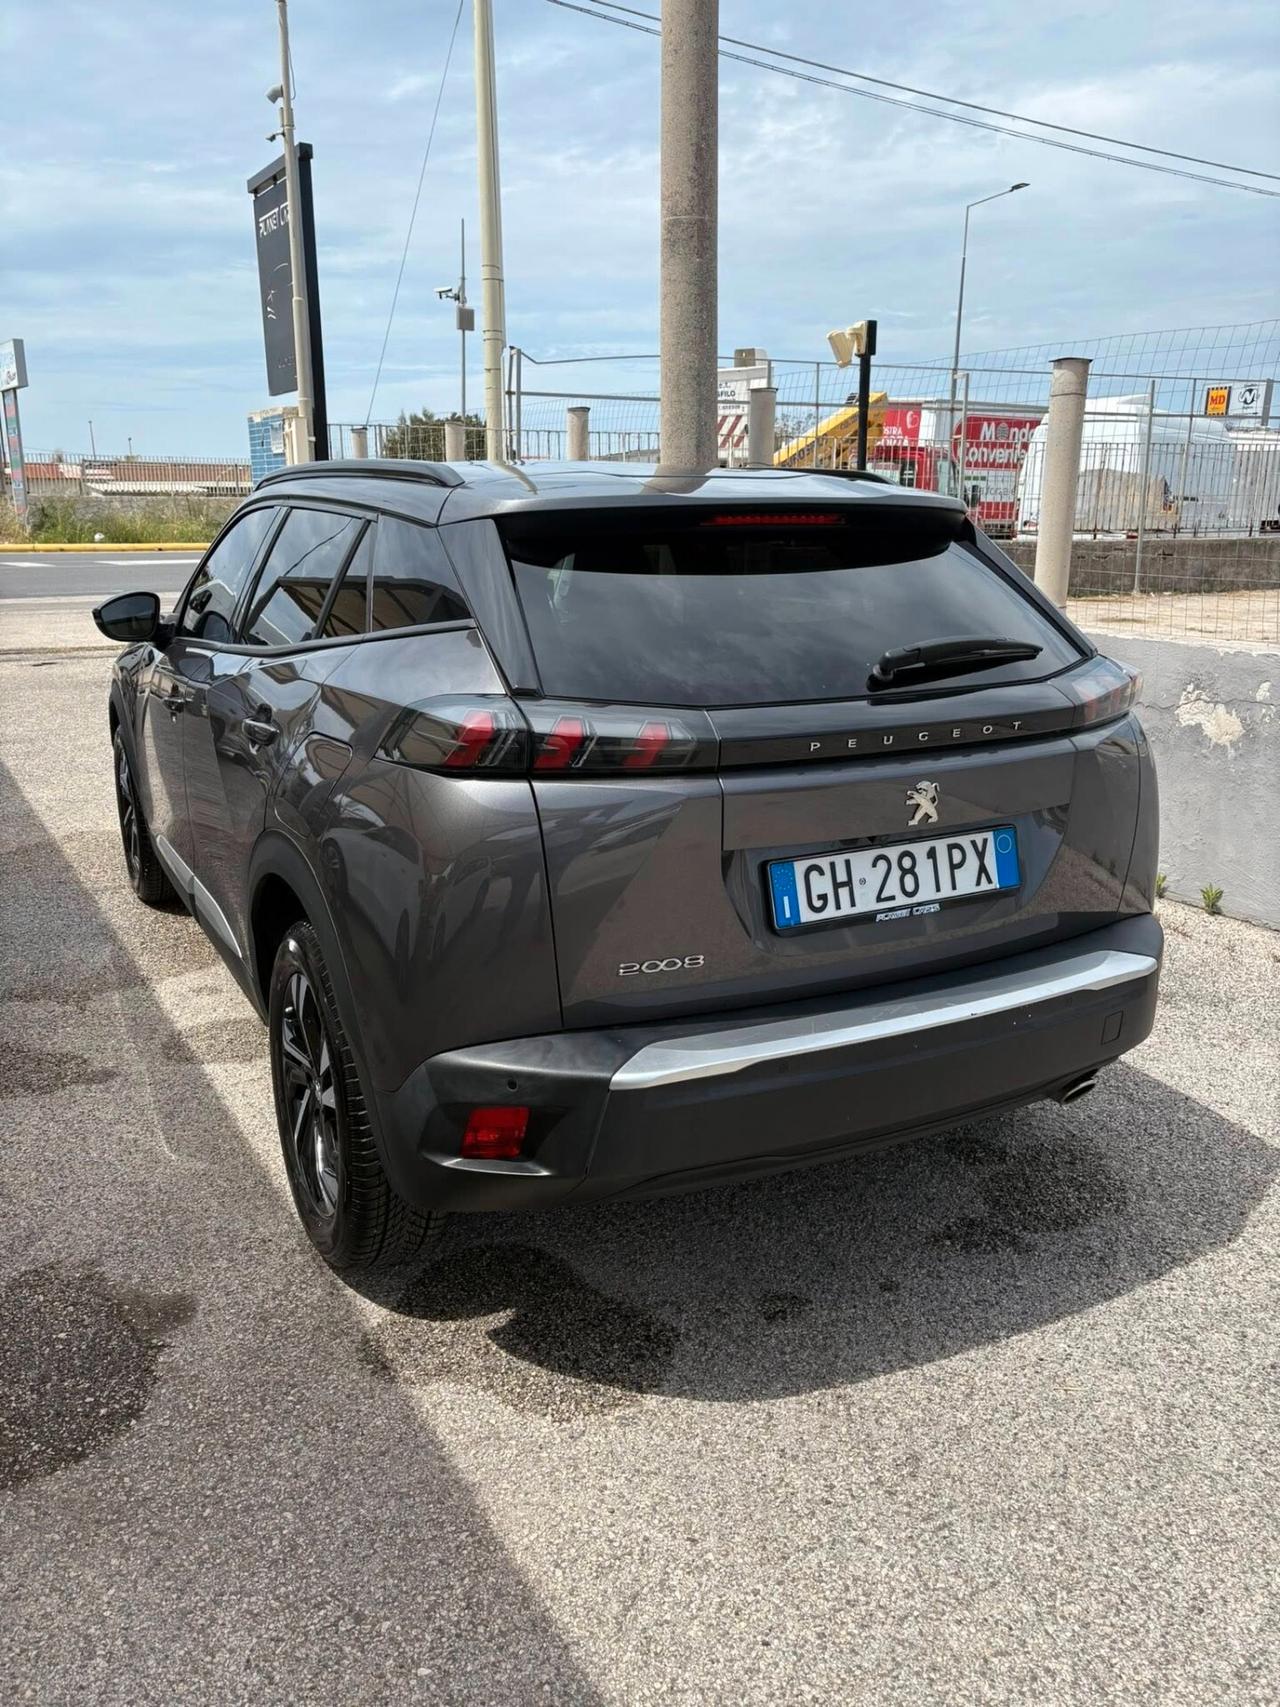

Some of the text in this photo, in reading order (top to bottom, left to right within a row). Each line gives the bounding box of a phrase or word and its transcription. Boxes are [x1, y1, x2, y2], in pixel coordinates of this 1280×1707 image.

[1209, 395, 1226, 405] MD
[810, 721, 1021, 752] PEUGEOT
[619, 955, 704, 976] 2008
